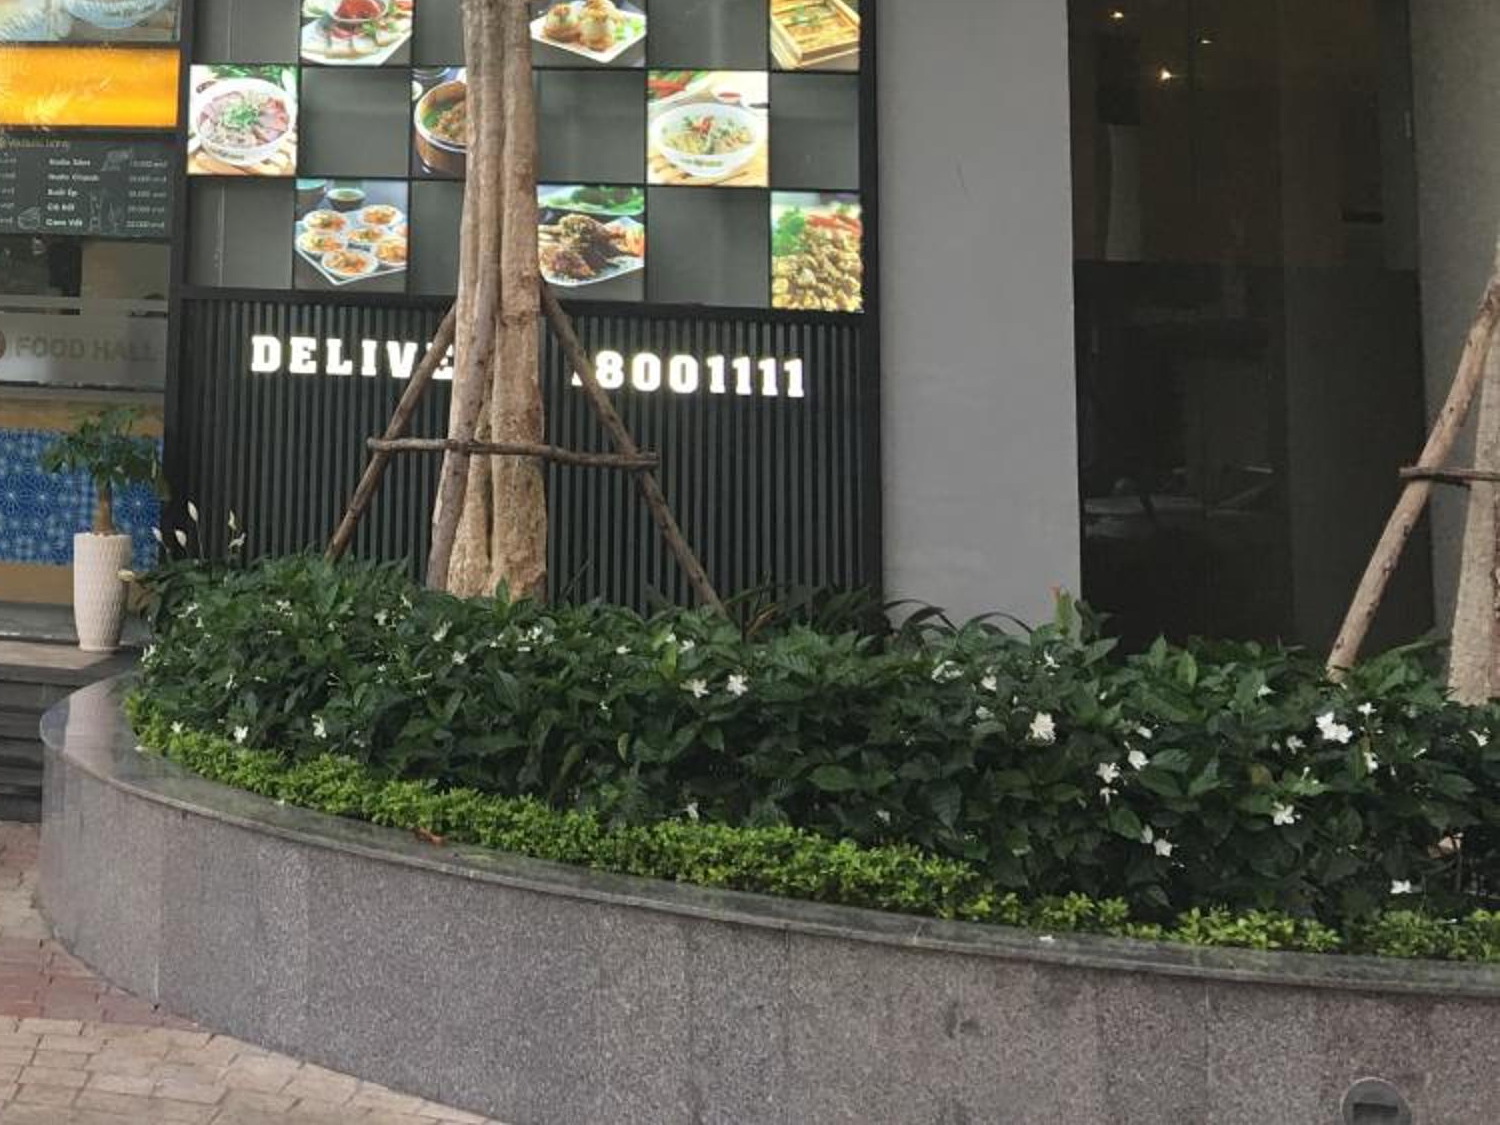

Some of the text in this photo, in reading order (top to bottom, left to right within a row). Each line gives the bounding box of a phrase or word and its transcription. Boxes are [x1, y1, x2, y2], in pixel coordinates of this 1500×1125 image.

[14, 335, 87, 361] FOOD
[250, 335, 805, 399] DELIV 8001111
